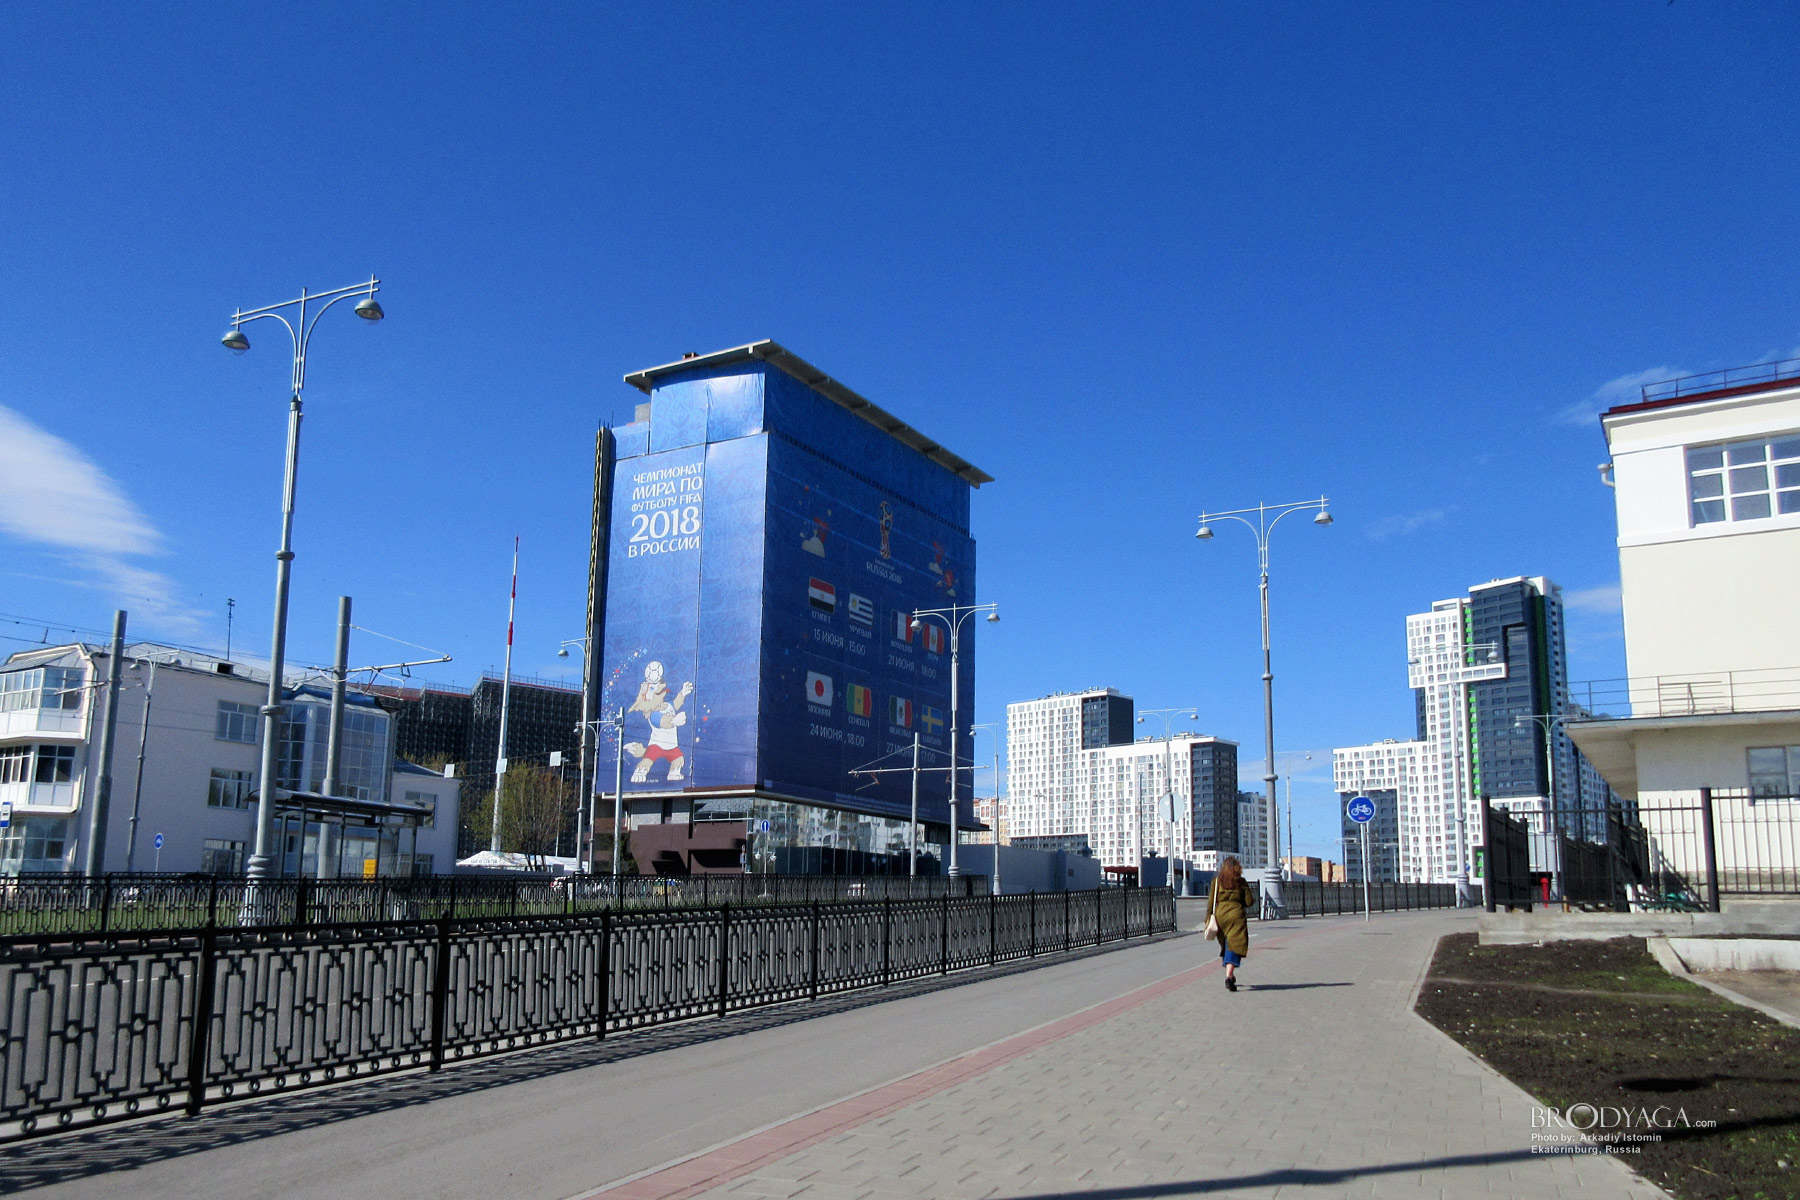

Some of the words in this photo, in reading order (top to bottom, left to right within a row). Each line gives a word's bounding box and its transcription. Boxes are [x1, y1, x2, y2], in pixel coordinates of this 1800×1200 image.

[633, 462, 703, 484] ЧЕМПИОНАТ
[632, 480, 676, 501] МИРА
[680, 476, 703, 493] ПО
[631, 496, 678, 512] ФУТБОЛУ
[679, 493, 702, 505] FIFA
[629, 506, 700, 543] 2018
[628, 545, 638, 558] В
[640, 535, 700, 556] РОССИИ
[813, 628, 821, 640] 15
[809, 723, 819, 736] 24
